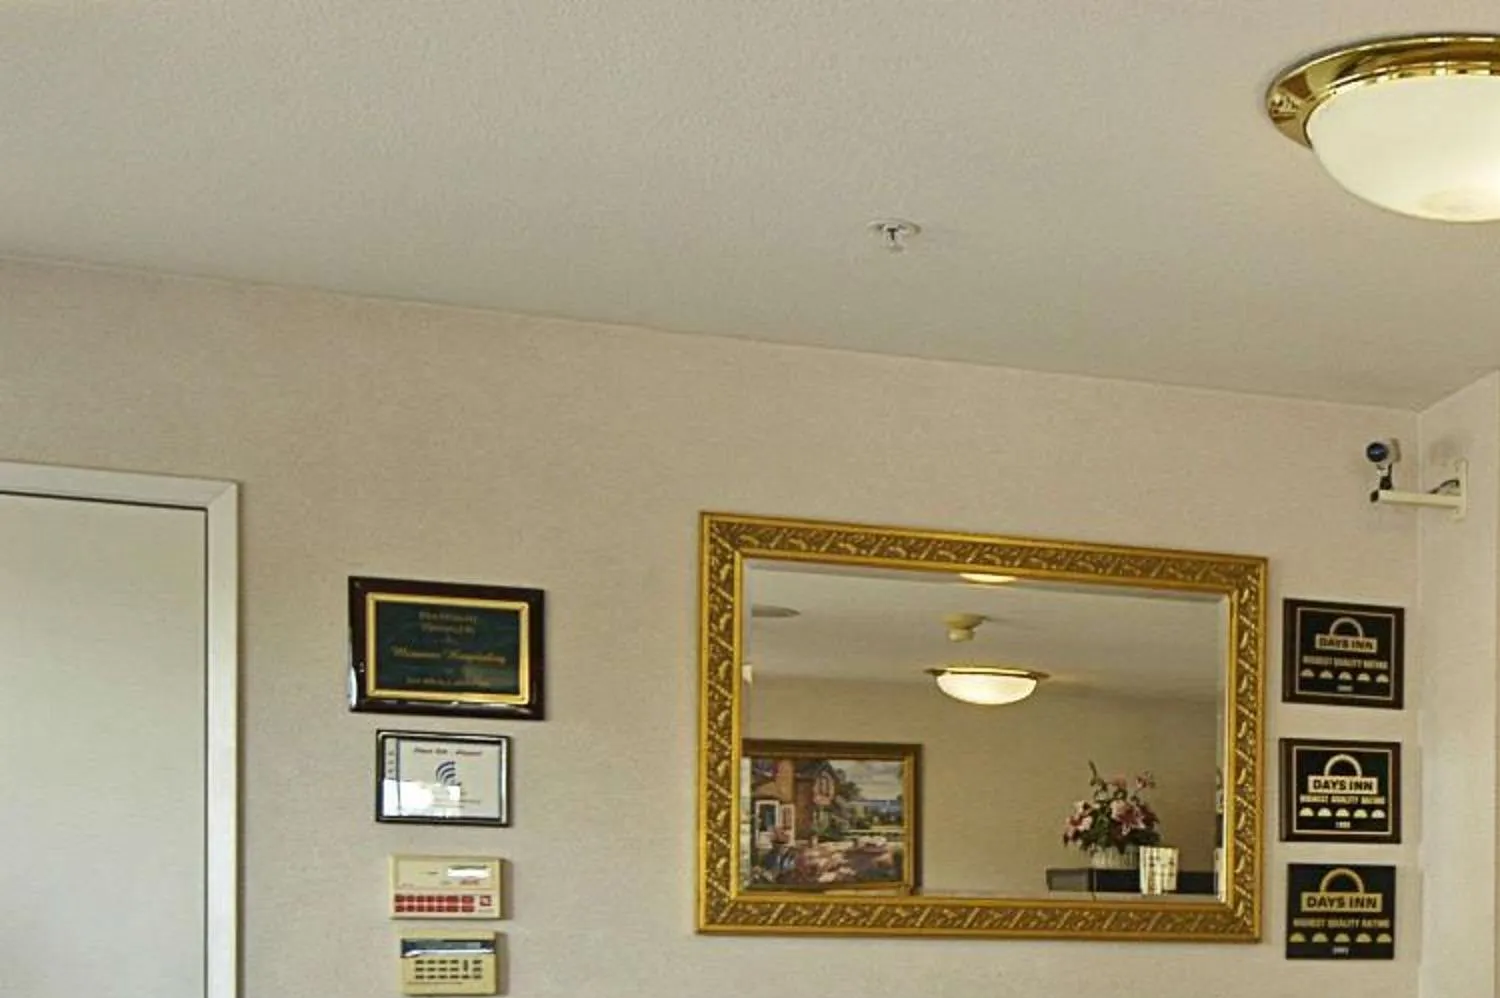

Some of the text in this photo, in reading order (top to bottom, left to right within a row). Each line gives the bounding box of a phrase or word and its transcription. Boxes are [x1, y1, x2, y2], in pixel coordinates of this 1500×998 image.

[1319, 637, 1373, 650] DAYS INN
[1312, 778, 1373, 791] DAYS INN
[1306, 895, 1377, 909] DAYS INN
